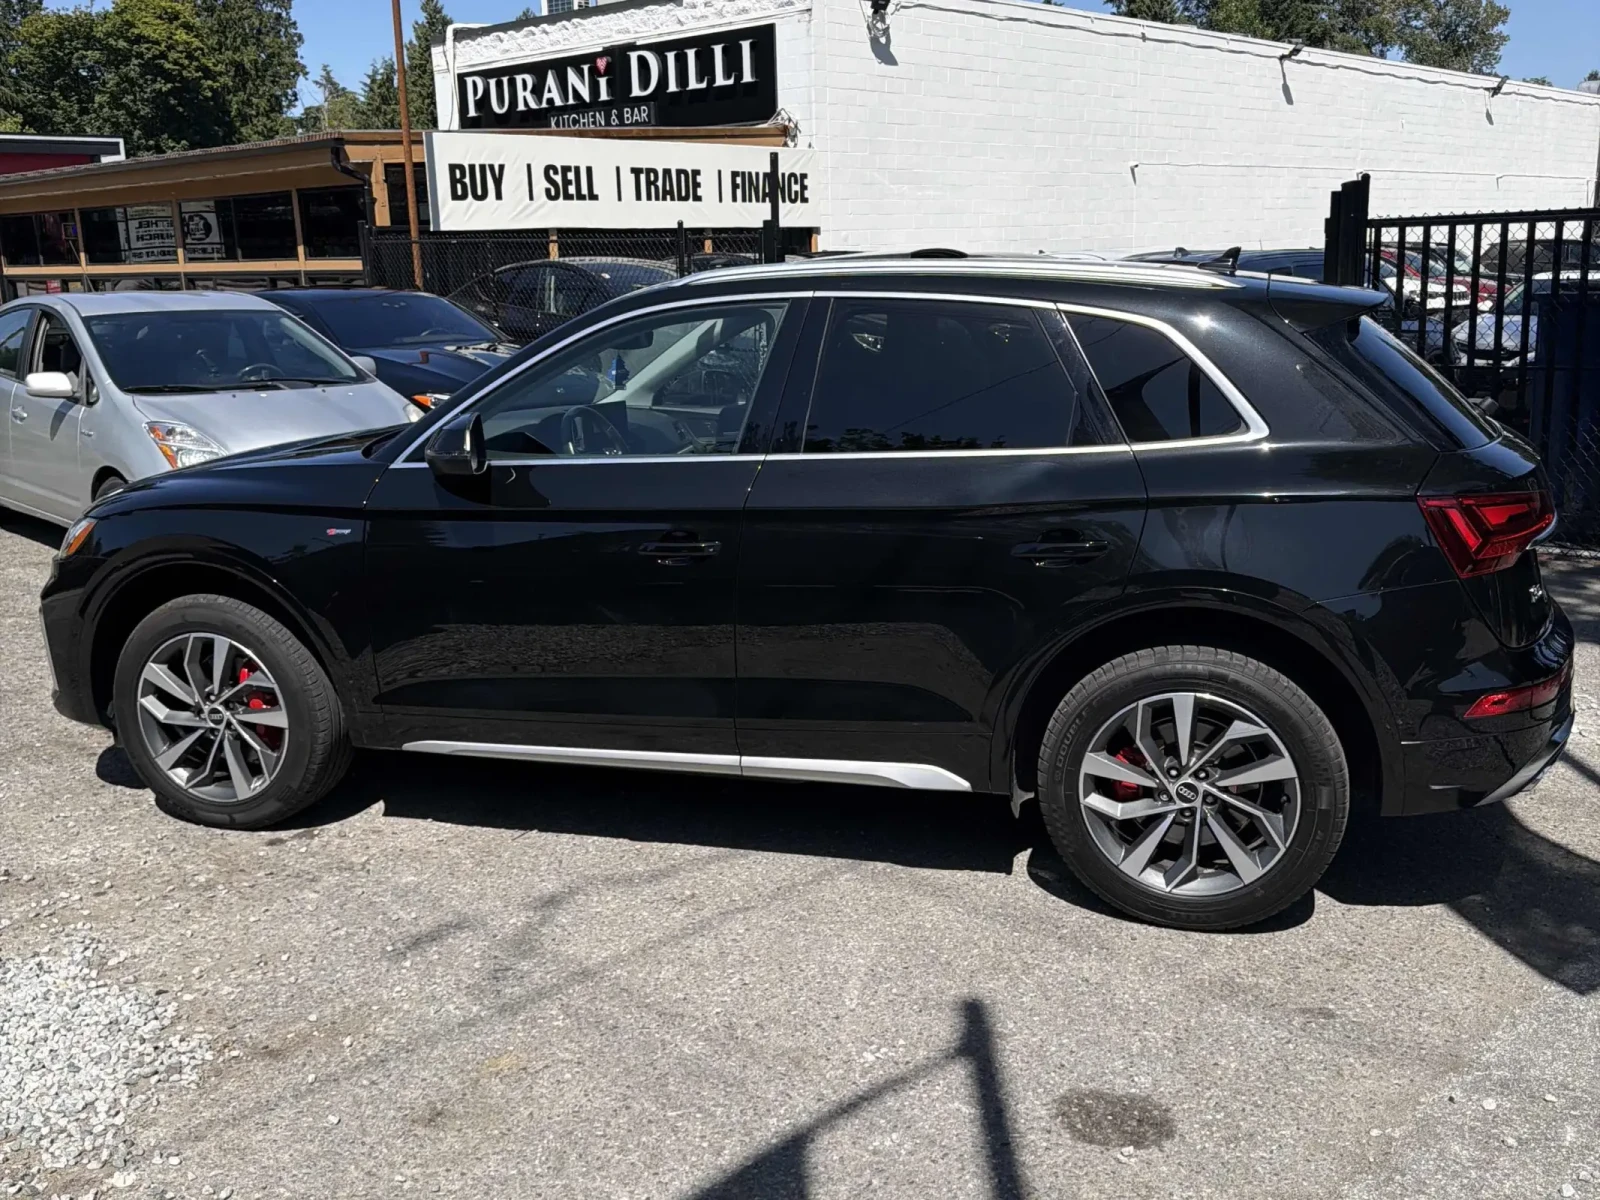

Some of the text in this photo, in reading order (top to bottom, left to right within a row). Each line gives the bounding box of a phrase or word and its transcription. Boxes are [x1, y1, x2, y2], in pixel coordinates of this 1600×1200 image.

[628, 39, 757, 98] DILLI
[550, 105, 649, 129] KITCHEN & BAR
[448, 162, 506, 201] BUY
[544, 163, 599, 201] SELL
[629, 166, 703, 203] TRADE
[730, 170, 809, 204] FINANCE
